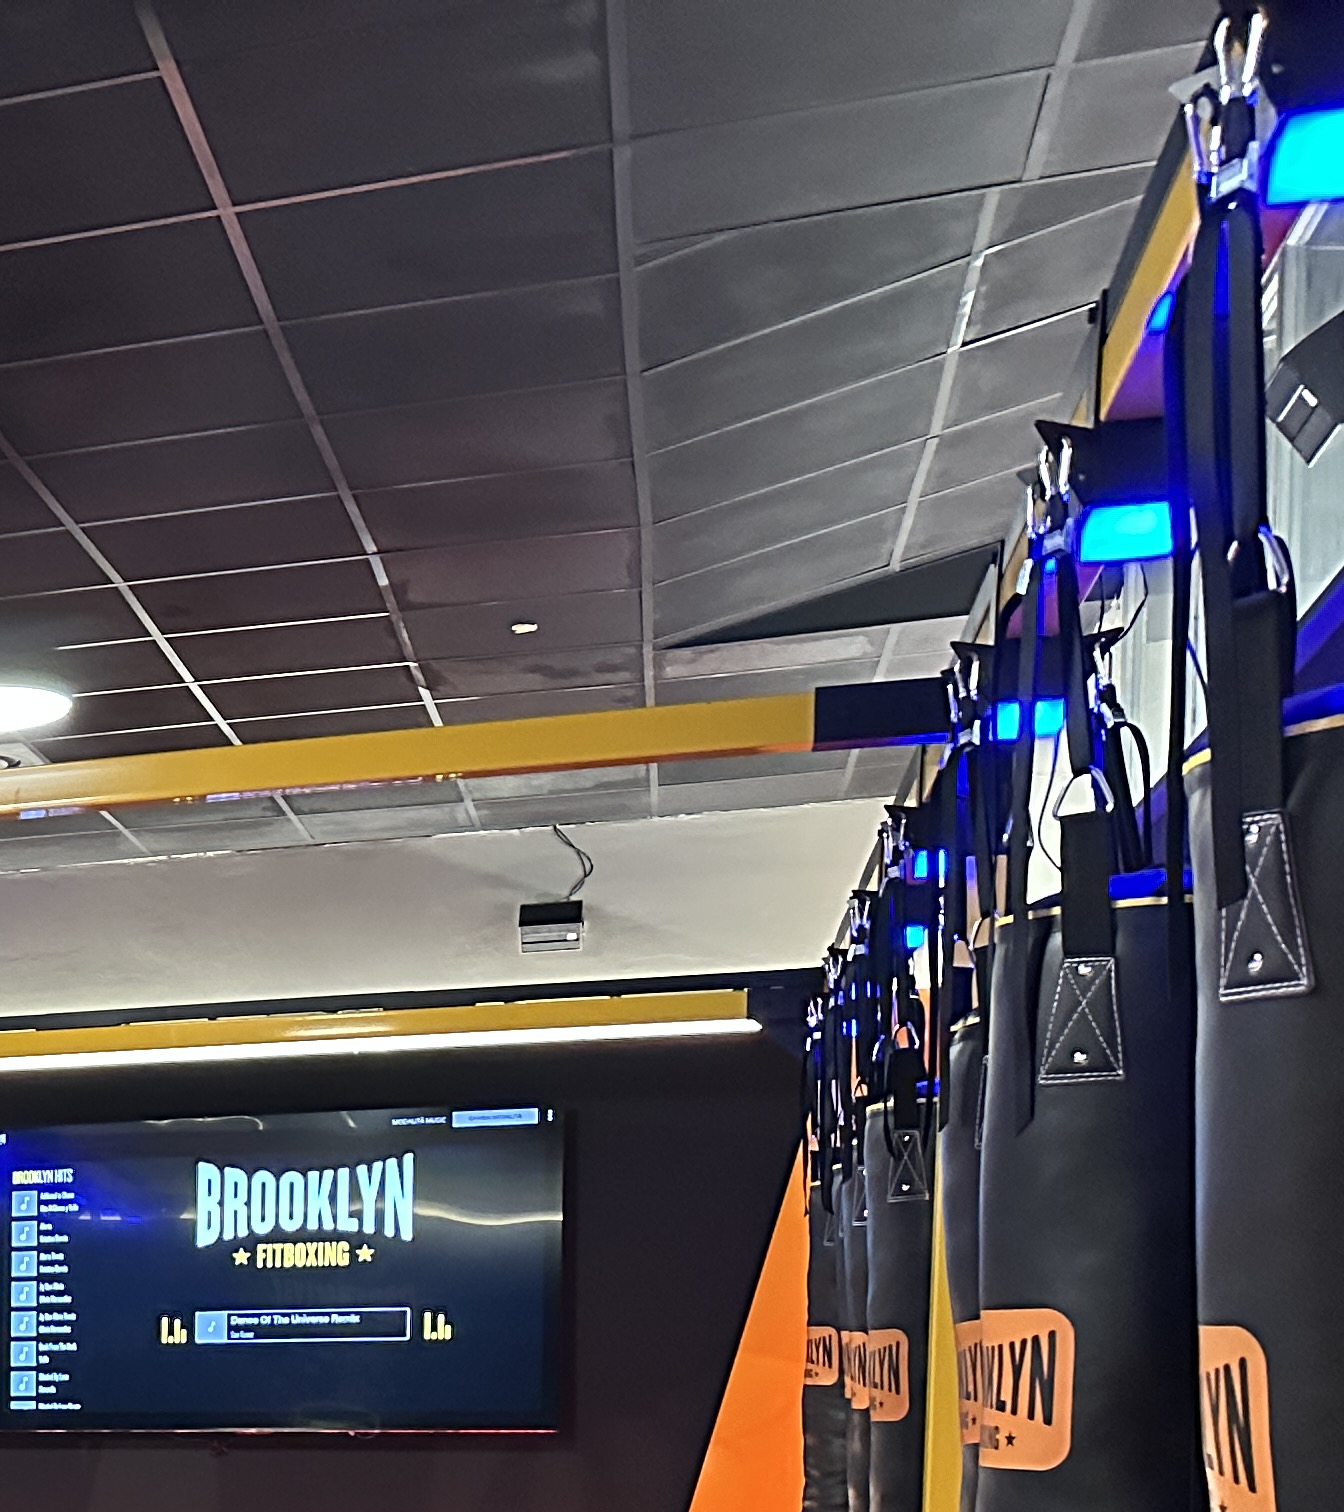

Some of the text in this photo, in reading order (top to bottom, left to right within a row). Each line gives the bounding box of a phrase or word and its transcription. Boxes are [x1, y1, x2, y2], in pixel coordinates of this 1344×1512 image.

[12, 1169, 53, 1185] BROOKLYN
[195, 1152, 415, 1249] BROOKLYN
[256, 1241, 351, 1269] FITBOXING
